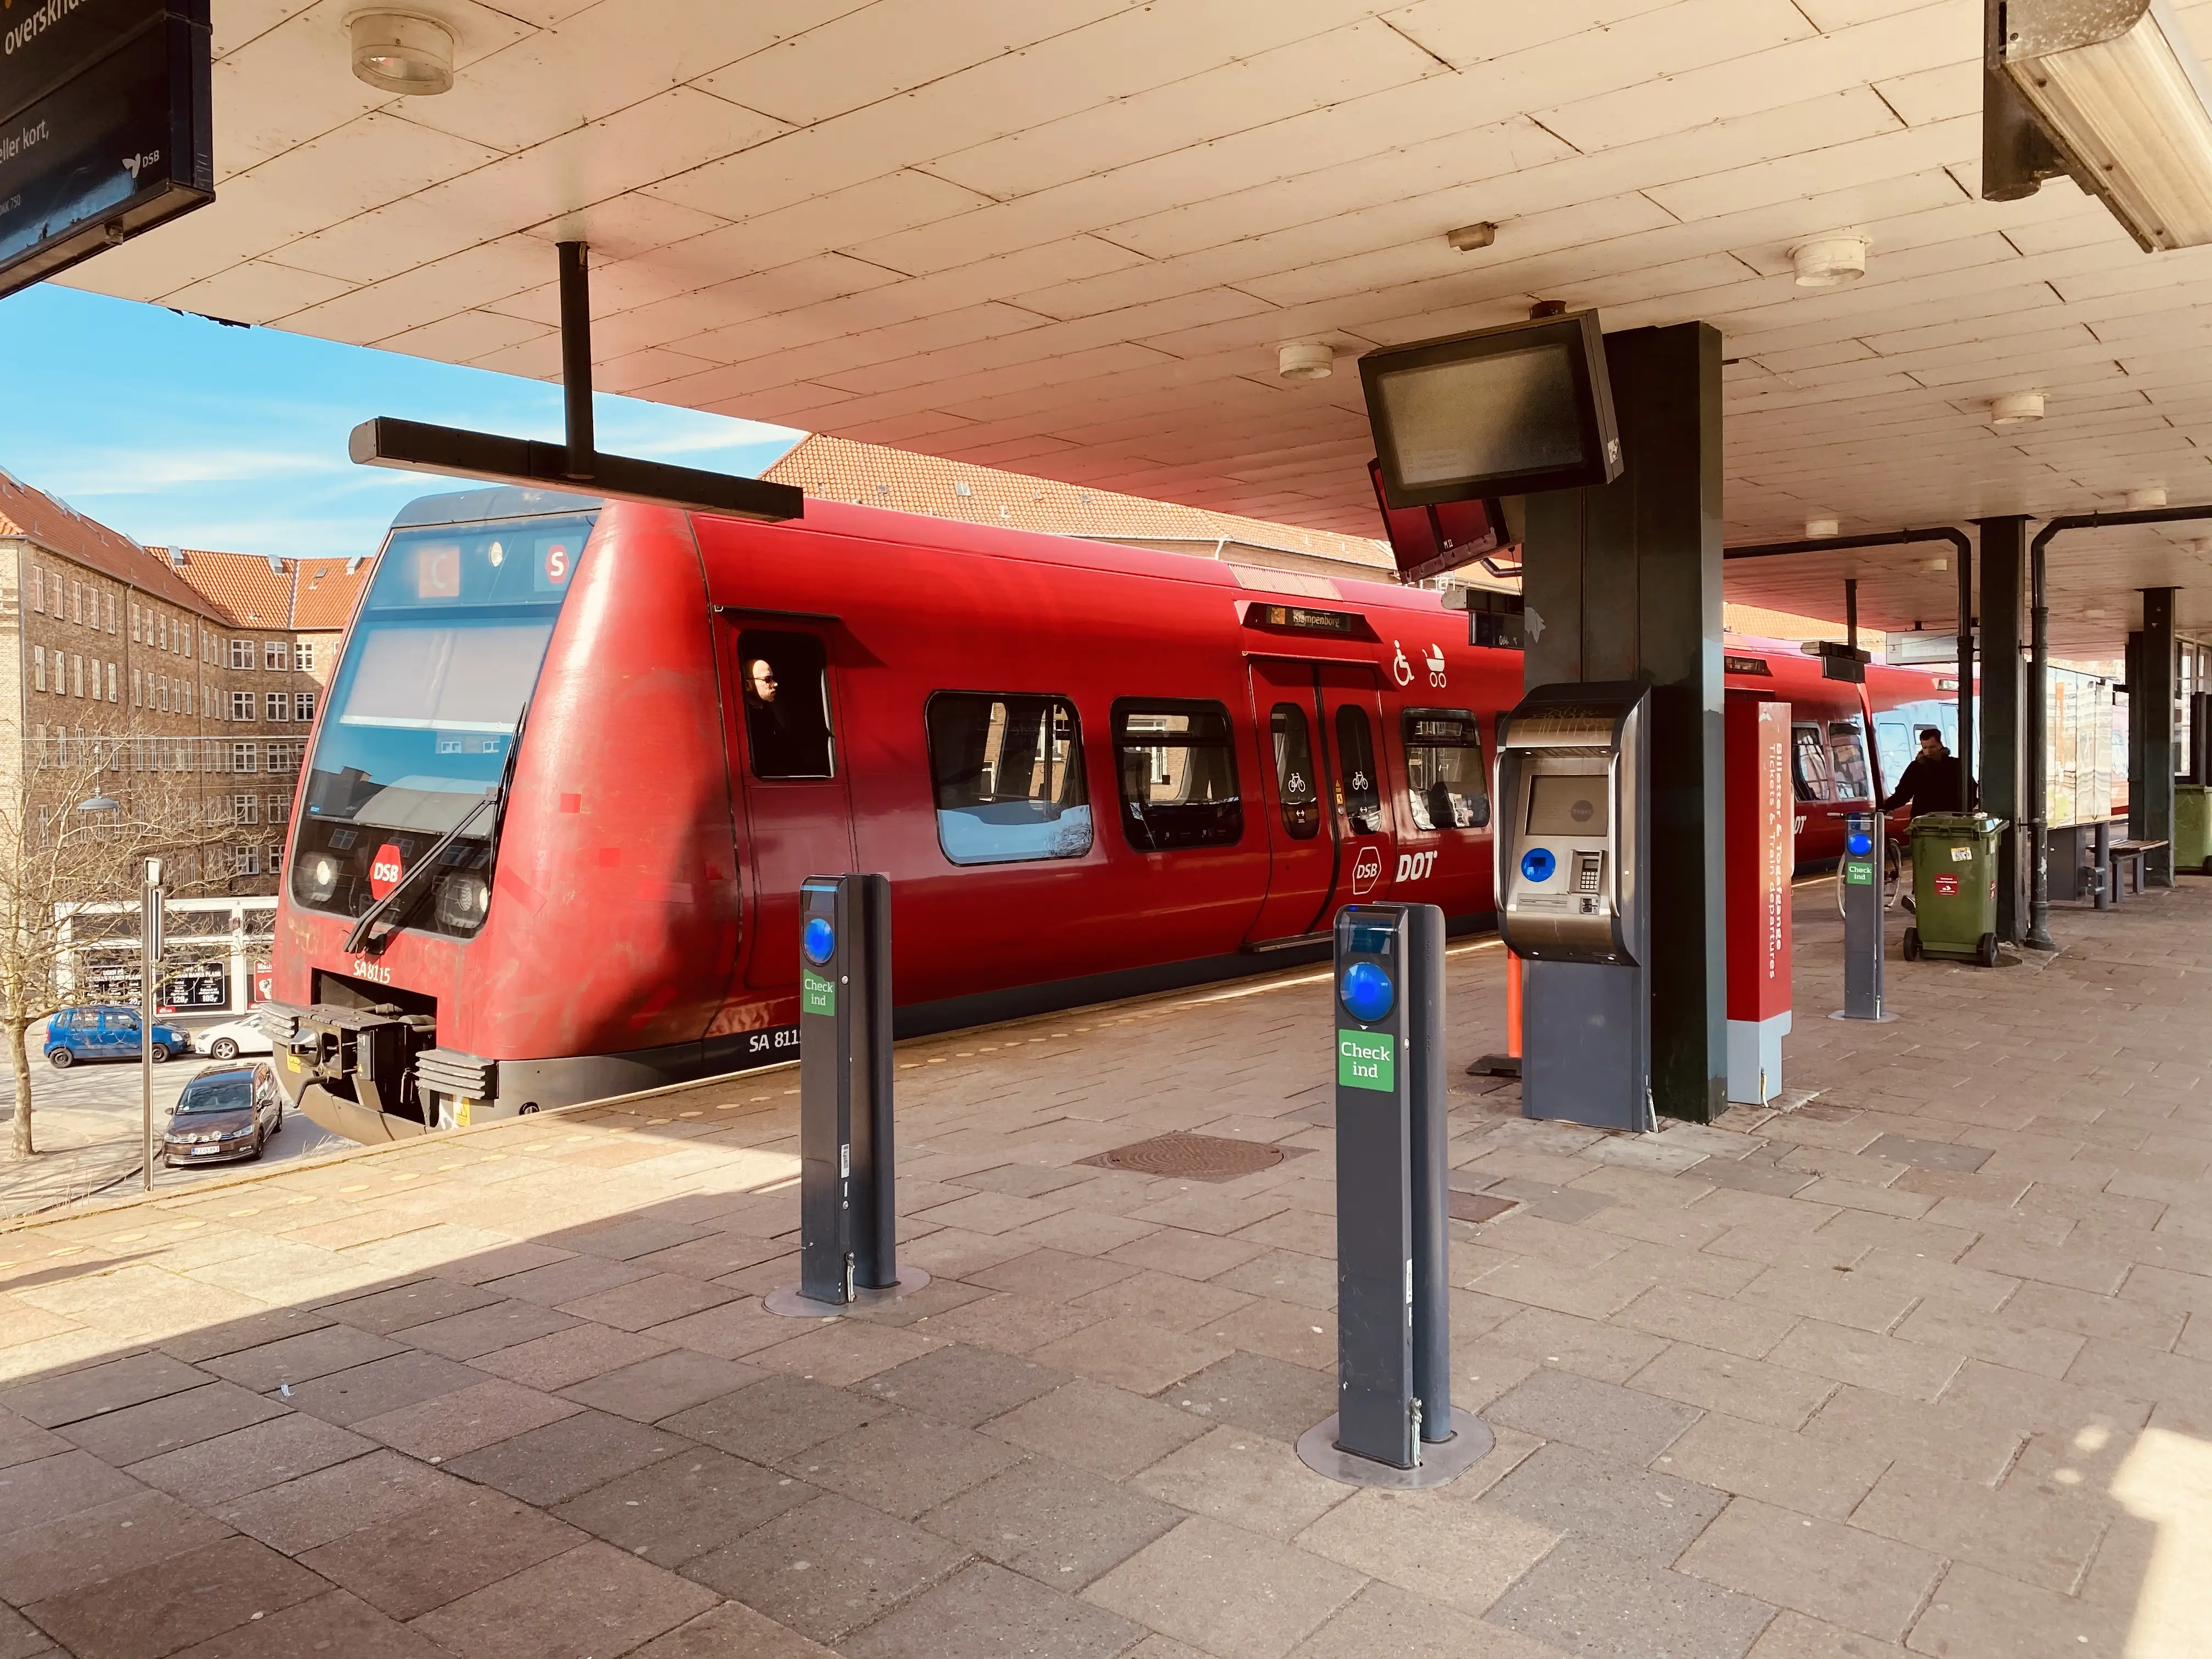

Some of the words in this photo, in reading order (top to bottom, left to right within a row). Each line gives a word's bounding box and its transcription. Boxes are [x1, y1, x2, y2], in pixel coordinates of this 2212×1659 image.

[22, 119, 49, 149] kort,
[143, 150, 160, 168] DSB
[550, 551, 564, 577] S
[1769, 812, 1776, 826] &
[1794, 815, 1807, 834] OT
[374, 862, 399, 883] DSB
[1356, 863, 1378, 879] DSB
[1395, 850, 1438, 883] DOT
[805, 979, 833, 993] Check
[811, 993, 826, 1006] ind
[749, 1034, 769, 1052] SA
[774, 1029, 800, 1047] 811
[1341, 1042, 1390, 1061] Check
[1353, 1061, 1378, 1079] ind
